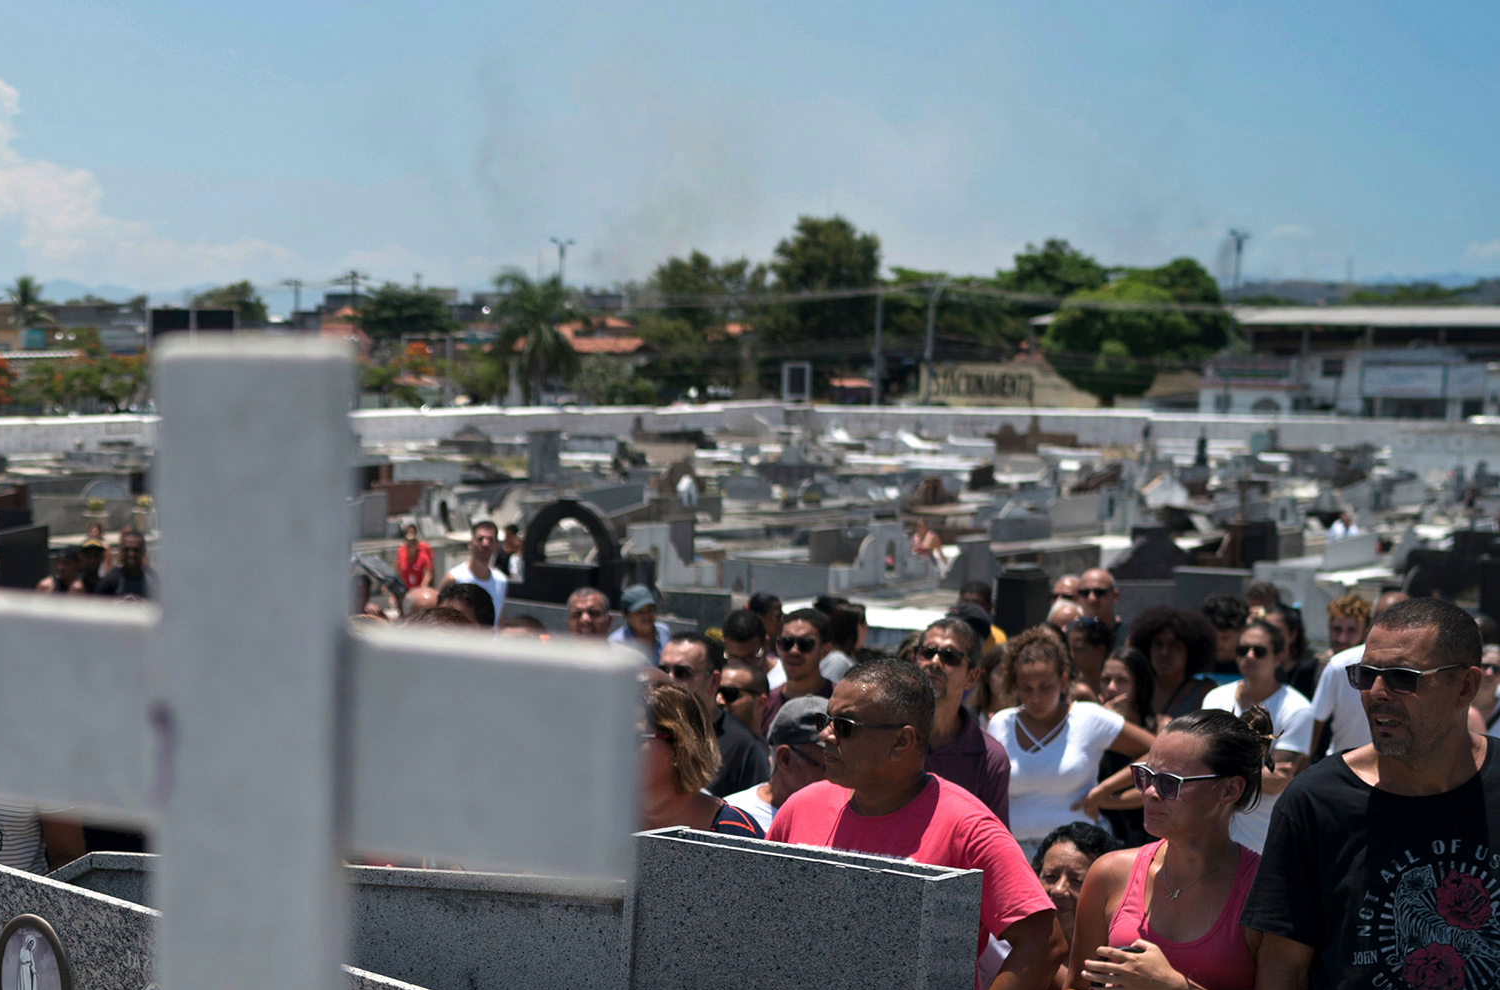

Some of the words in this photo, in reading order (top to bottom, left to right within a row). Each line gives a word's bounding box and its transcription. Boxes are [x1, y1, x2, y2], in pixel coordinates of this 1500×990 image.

[1357, 890, 1379, 937] NOT
[1380, 850, 1421, 883] ALL
[1431, 839, 1462, 855] OF
[1352, 950, 1378, 965] JOHN
